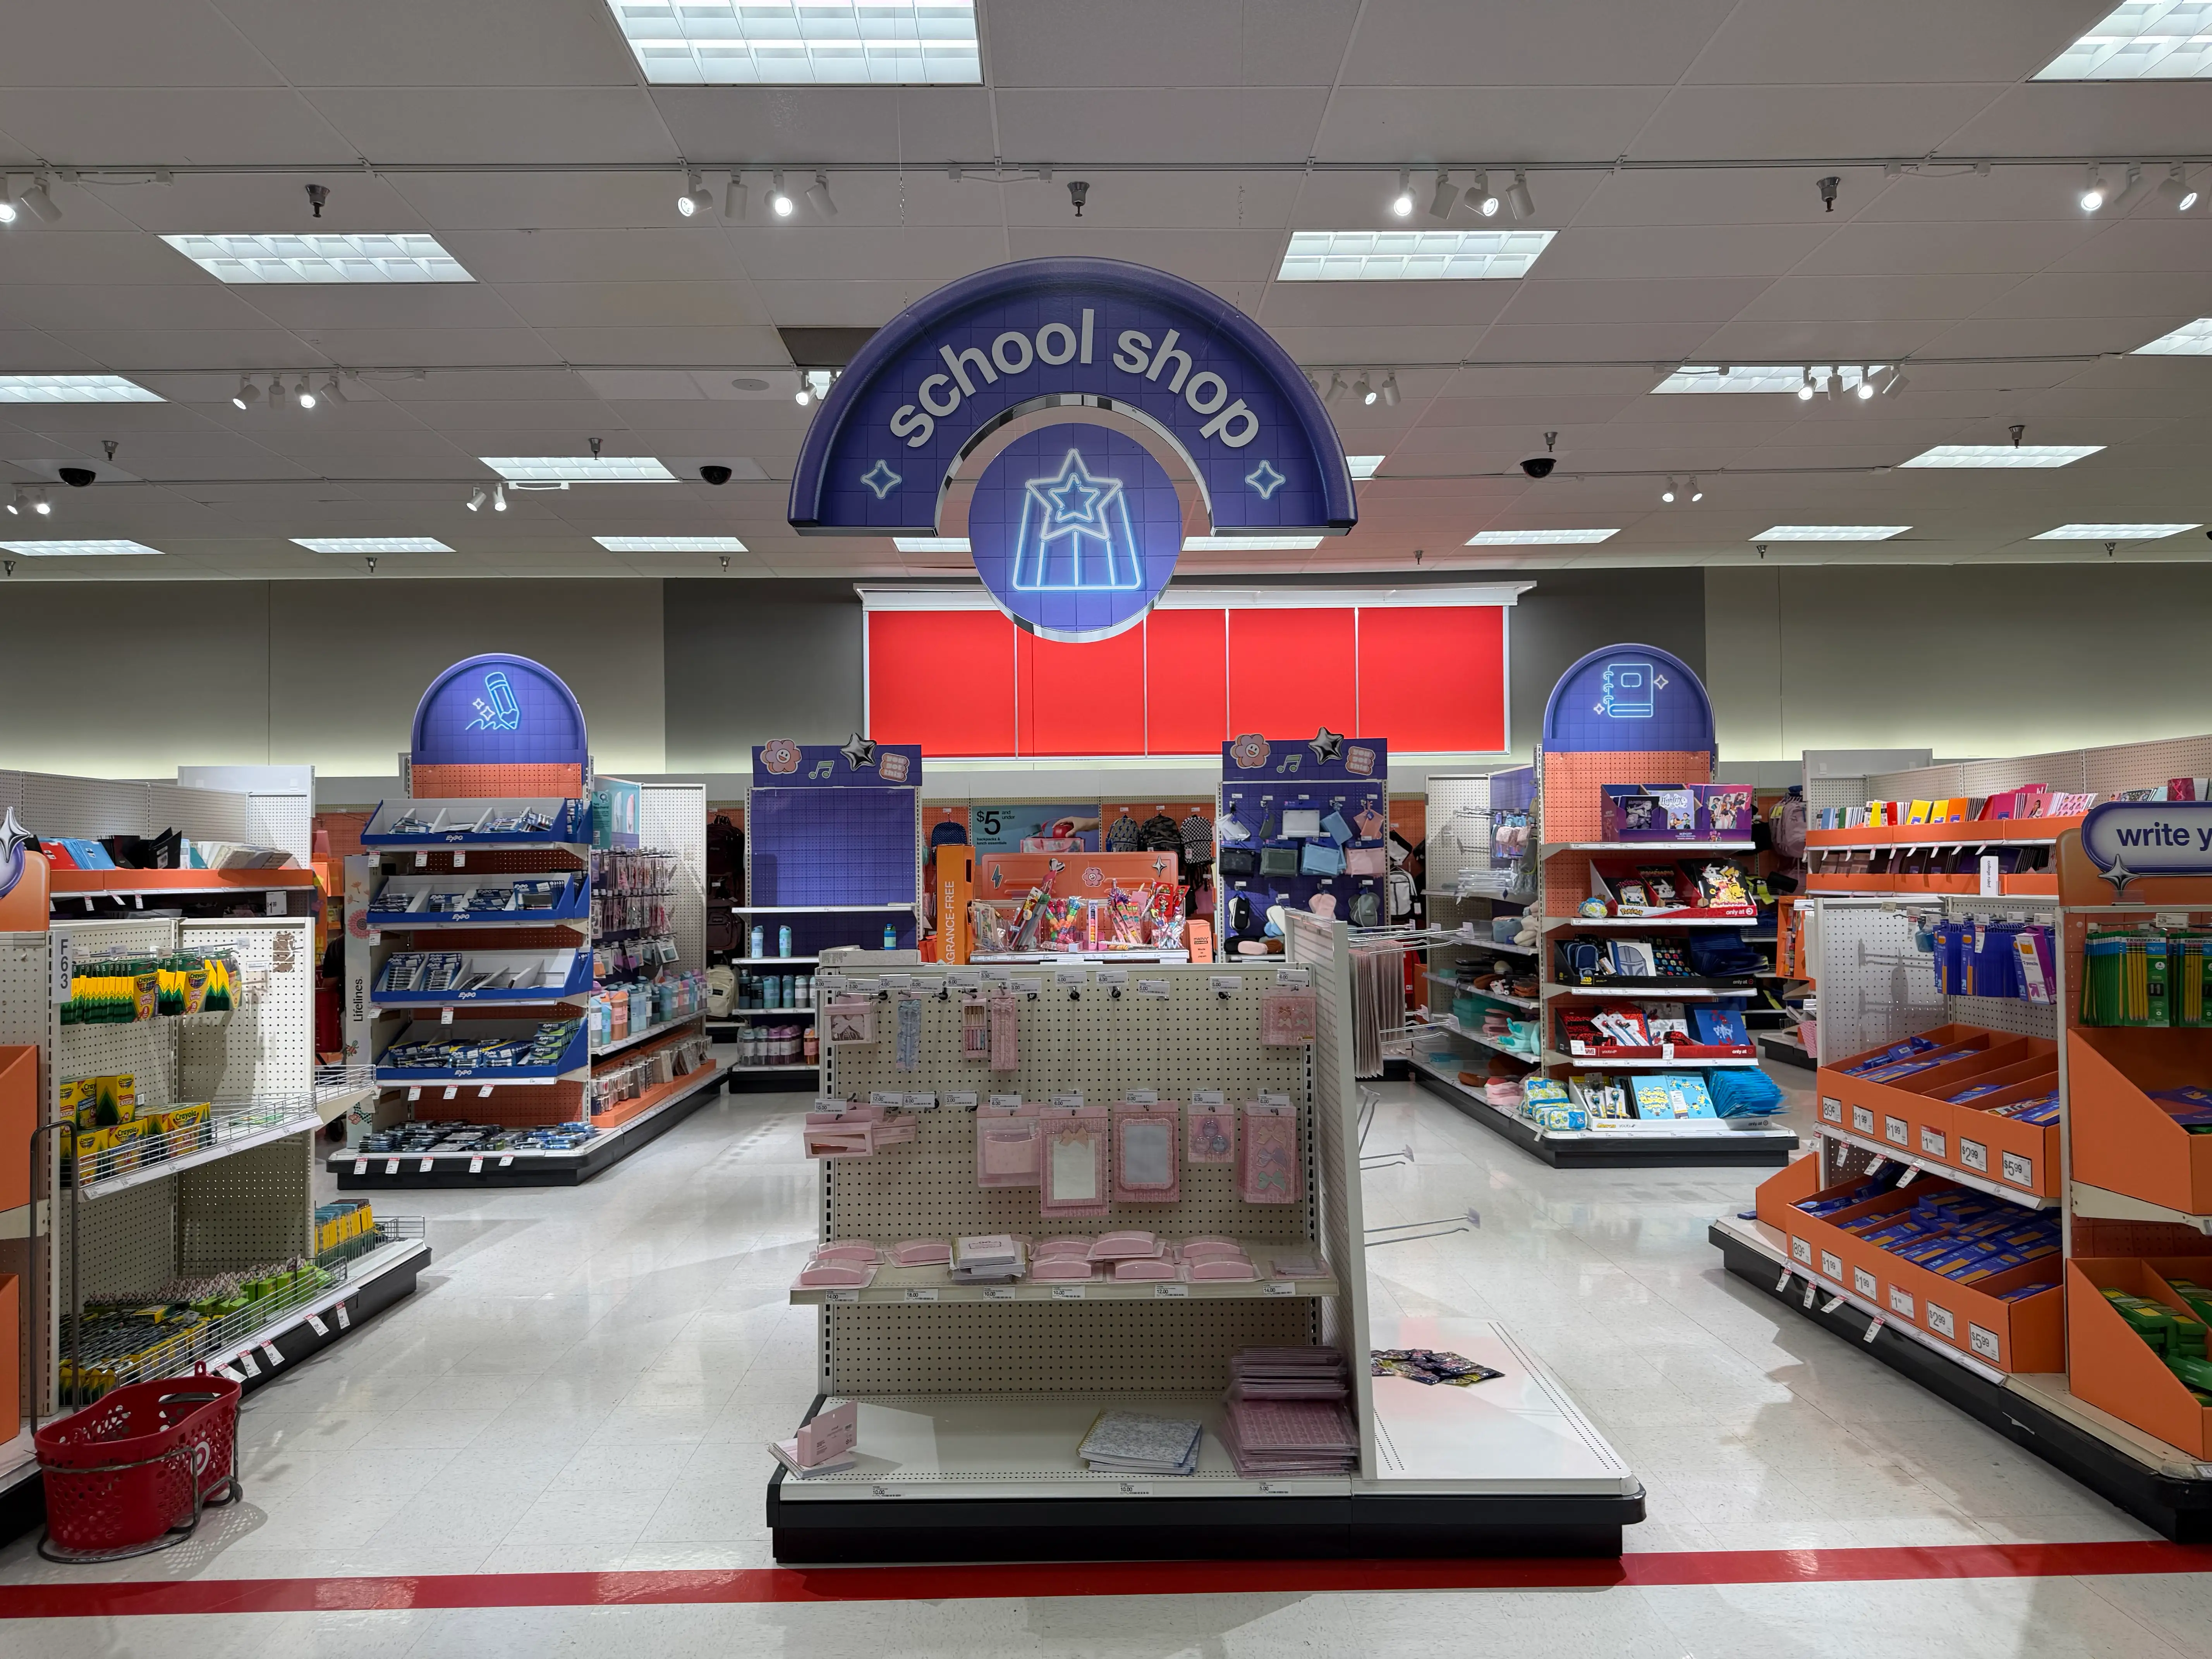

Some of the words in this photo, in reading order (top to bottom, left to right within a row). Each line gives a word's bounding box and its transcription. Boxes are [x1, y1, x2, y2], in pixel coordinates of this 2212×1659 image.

[889, 308, 1094, 449] school
[1112, 328, 1259, 449] shop
[977, 810, 1001, 835] $5
[2116, 822, 2190, 846] write
[2197, 828, 2212, 851] y
[353, 979, 363, 1021] Lifelines
[175, 1110, 197, 1120] Crayola
[1824, 1104, 1835, 1116] 89¢
[1854, 1113, 1867, 1126] $199
[118, 1127, 137, 1136] Crayola
[1887, 1123, 1901, 1137] $199
[1962, 1146, 1978, 1162] $299
[2004, 1160, 2023, 1176] $599
[1794, 1242, 1805, 1257] 89¢
[1822, 1257, 1836, 1271] $199
[1855, 1274, 1870, 1289] $199
[1929, 1310, 1946, 1327] $299
[1972, 1331, 1990, 1349] $599
